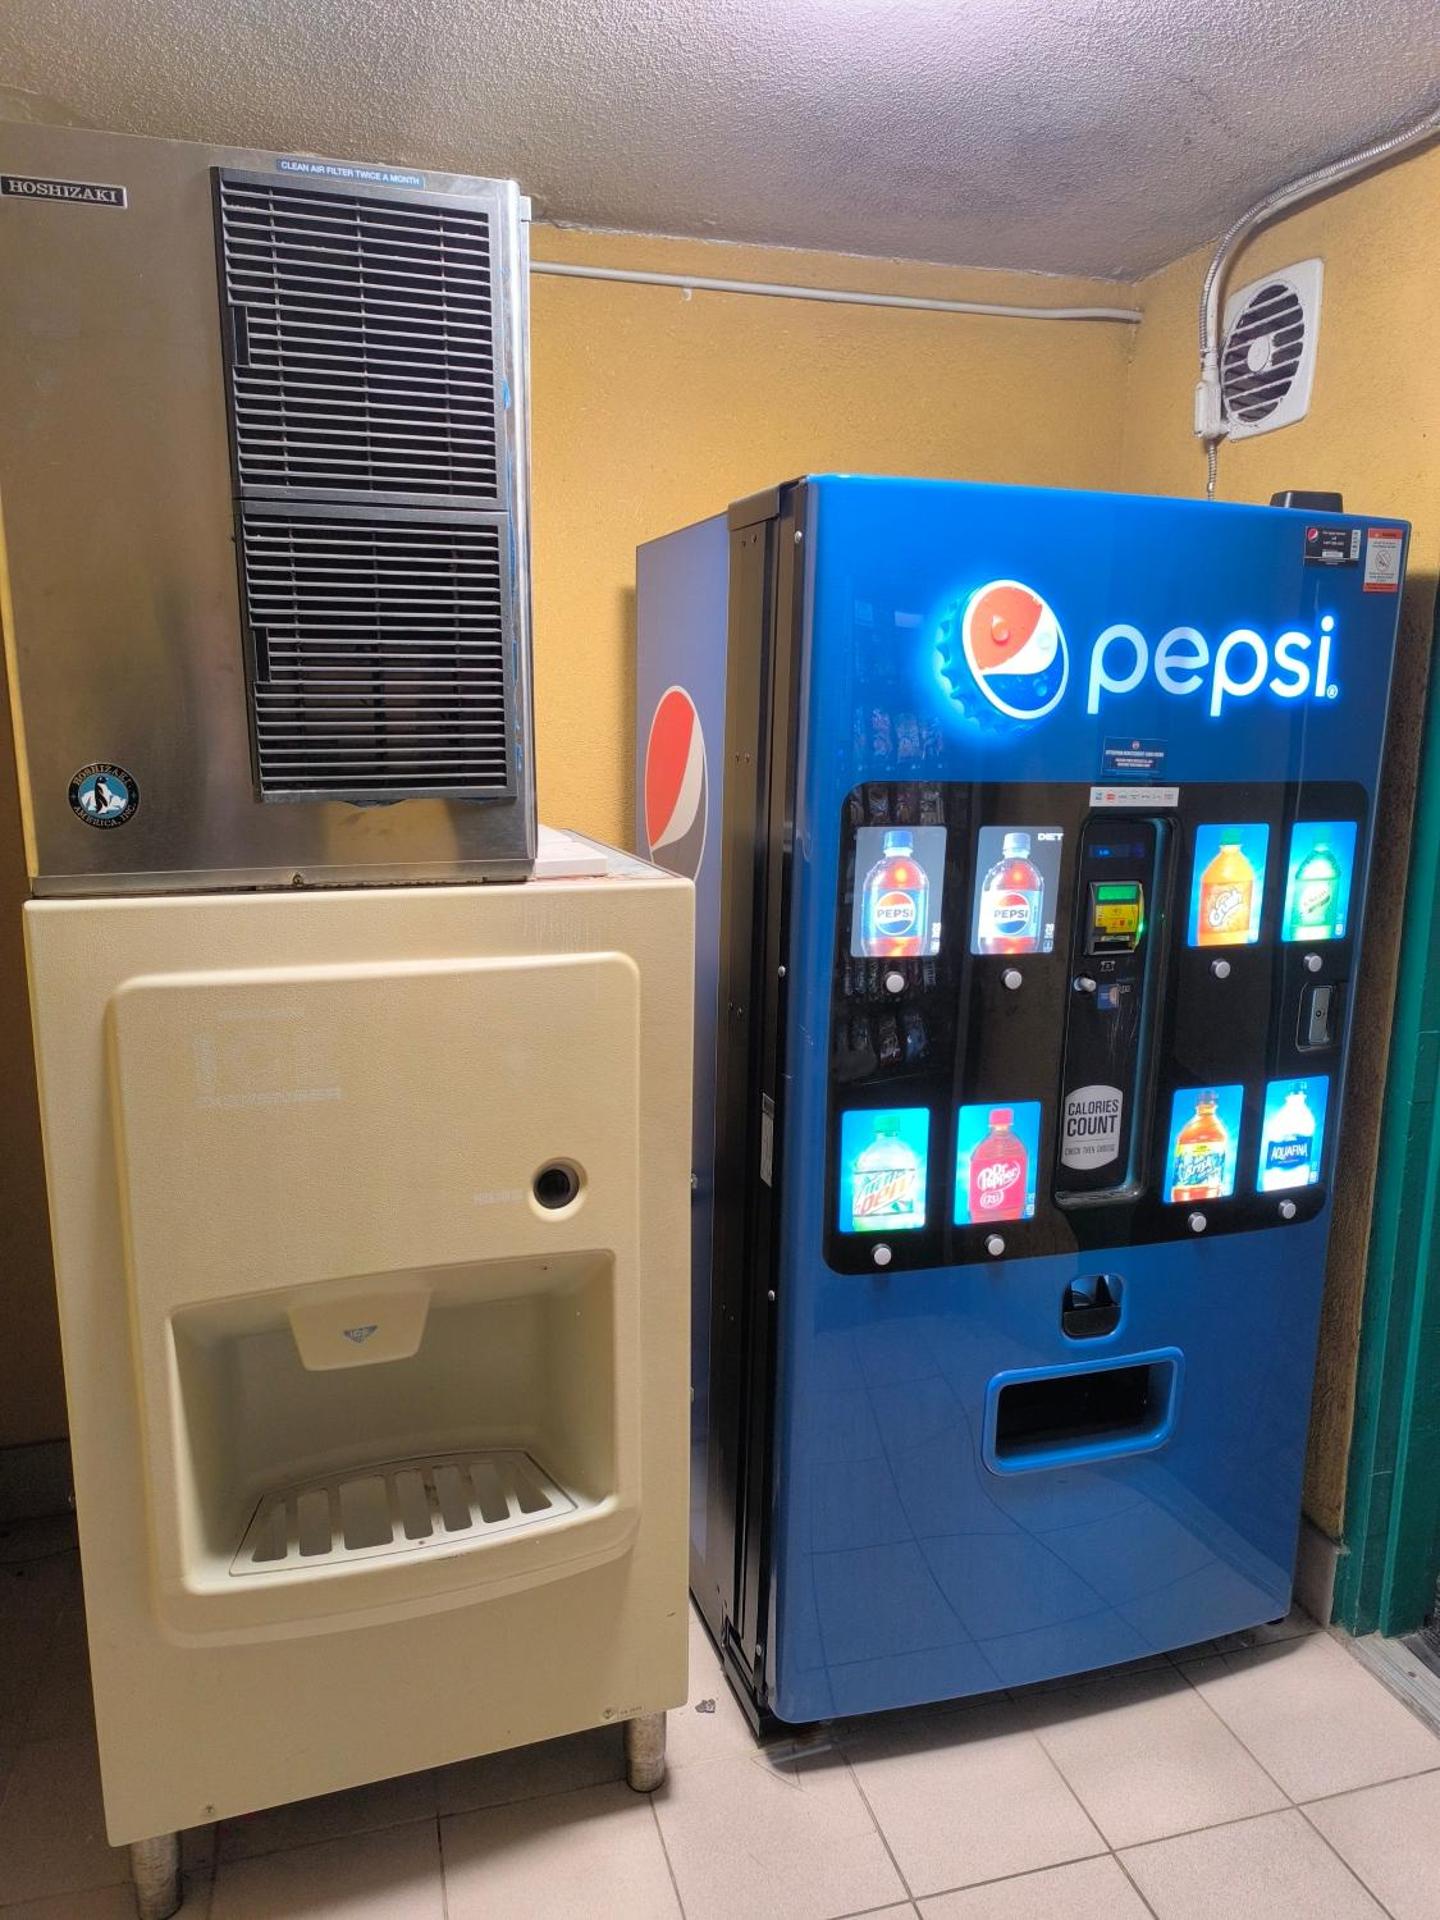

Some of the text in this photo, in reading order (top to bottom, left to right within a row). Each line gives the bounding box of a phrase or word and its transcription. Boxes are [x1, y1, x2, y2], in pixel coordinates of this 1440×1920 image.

[280, 160, 310, 173] CLEAN
[310, 164, 326, 174] AIR
[326, 167, 354, 177] FILTER
[355, 170, 381, 181] TWICE
[390, 175, 420, 185] MONTH
[8, 179, 118, 204] HOSHIZAKI
[1087, 615, 1335, 717] pepsi
[1037, 832, 1064, 841] DIET
[876, 908, 913, 919] PEPSI
[993, 909, 1029, 919] PEPSI
[1068, 1099, 1120, 1116] CALORIES
[1066, 1115, 1118, 1137] COUNT
[1271, 1143, 1308, 1162] AQUAFINA
